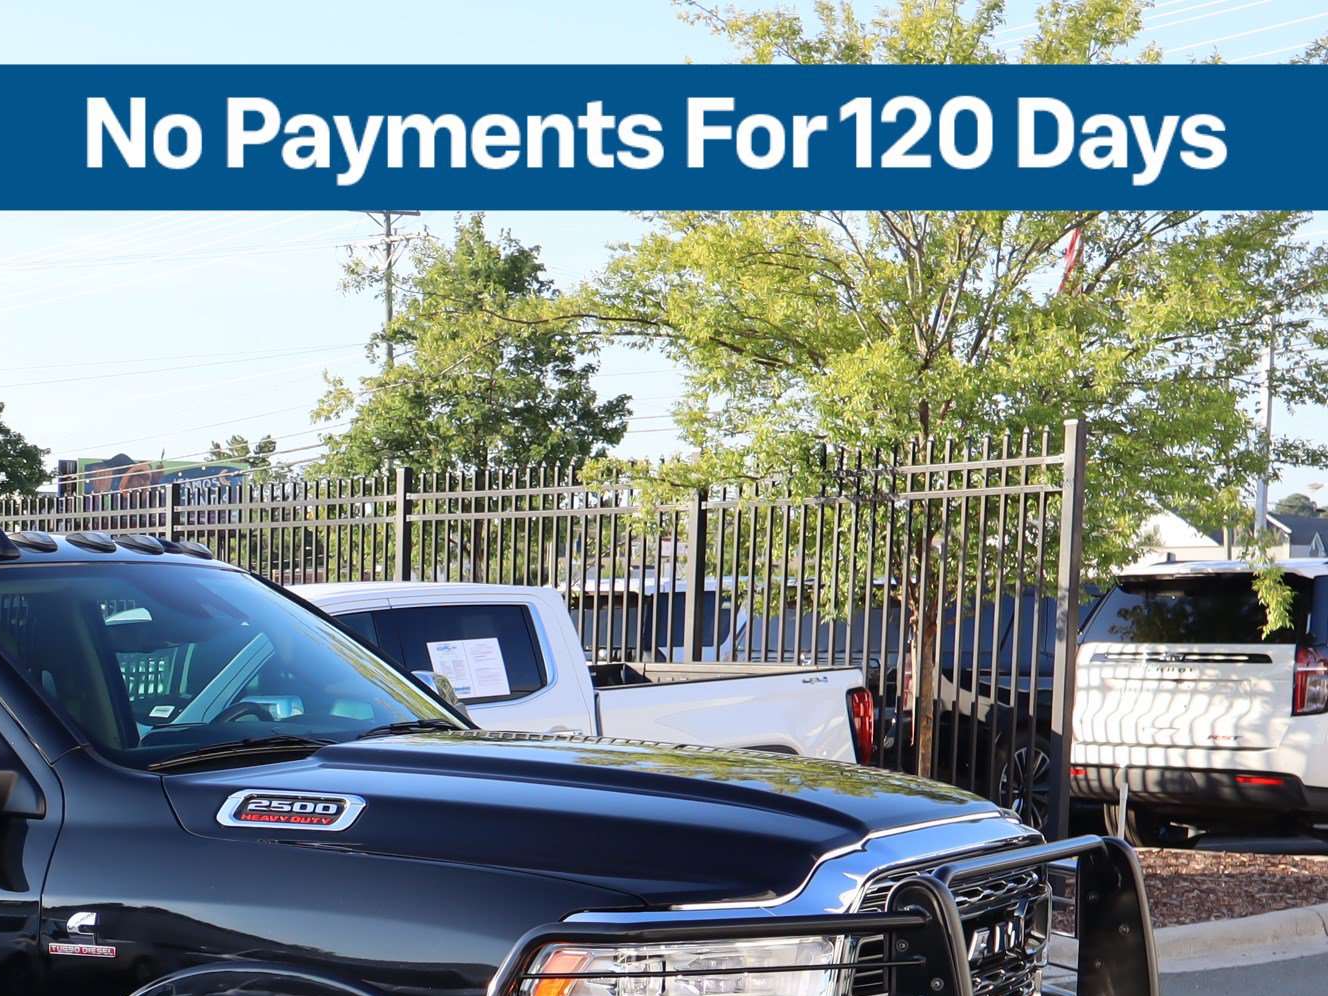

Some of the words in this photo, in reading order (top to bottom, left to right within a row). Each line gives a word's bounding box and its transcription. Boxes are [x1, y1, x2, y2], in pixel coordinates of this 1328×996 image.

[247, 800, 338, 815] 2500
[241, 814, 288, 823] HEAVY
[290, 816, 333, 825] DUTY
[51, 945, 81, 953] TURBO
[82, 947, 114, 956] DIESEL
